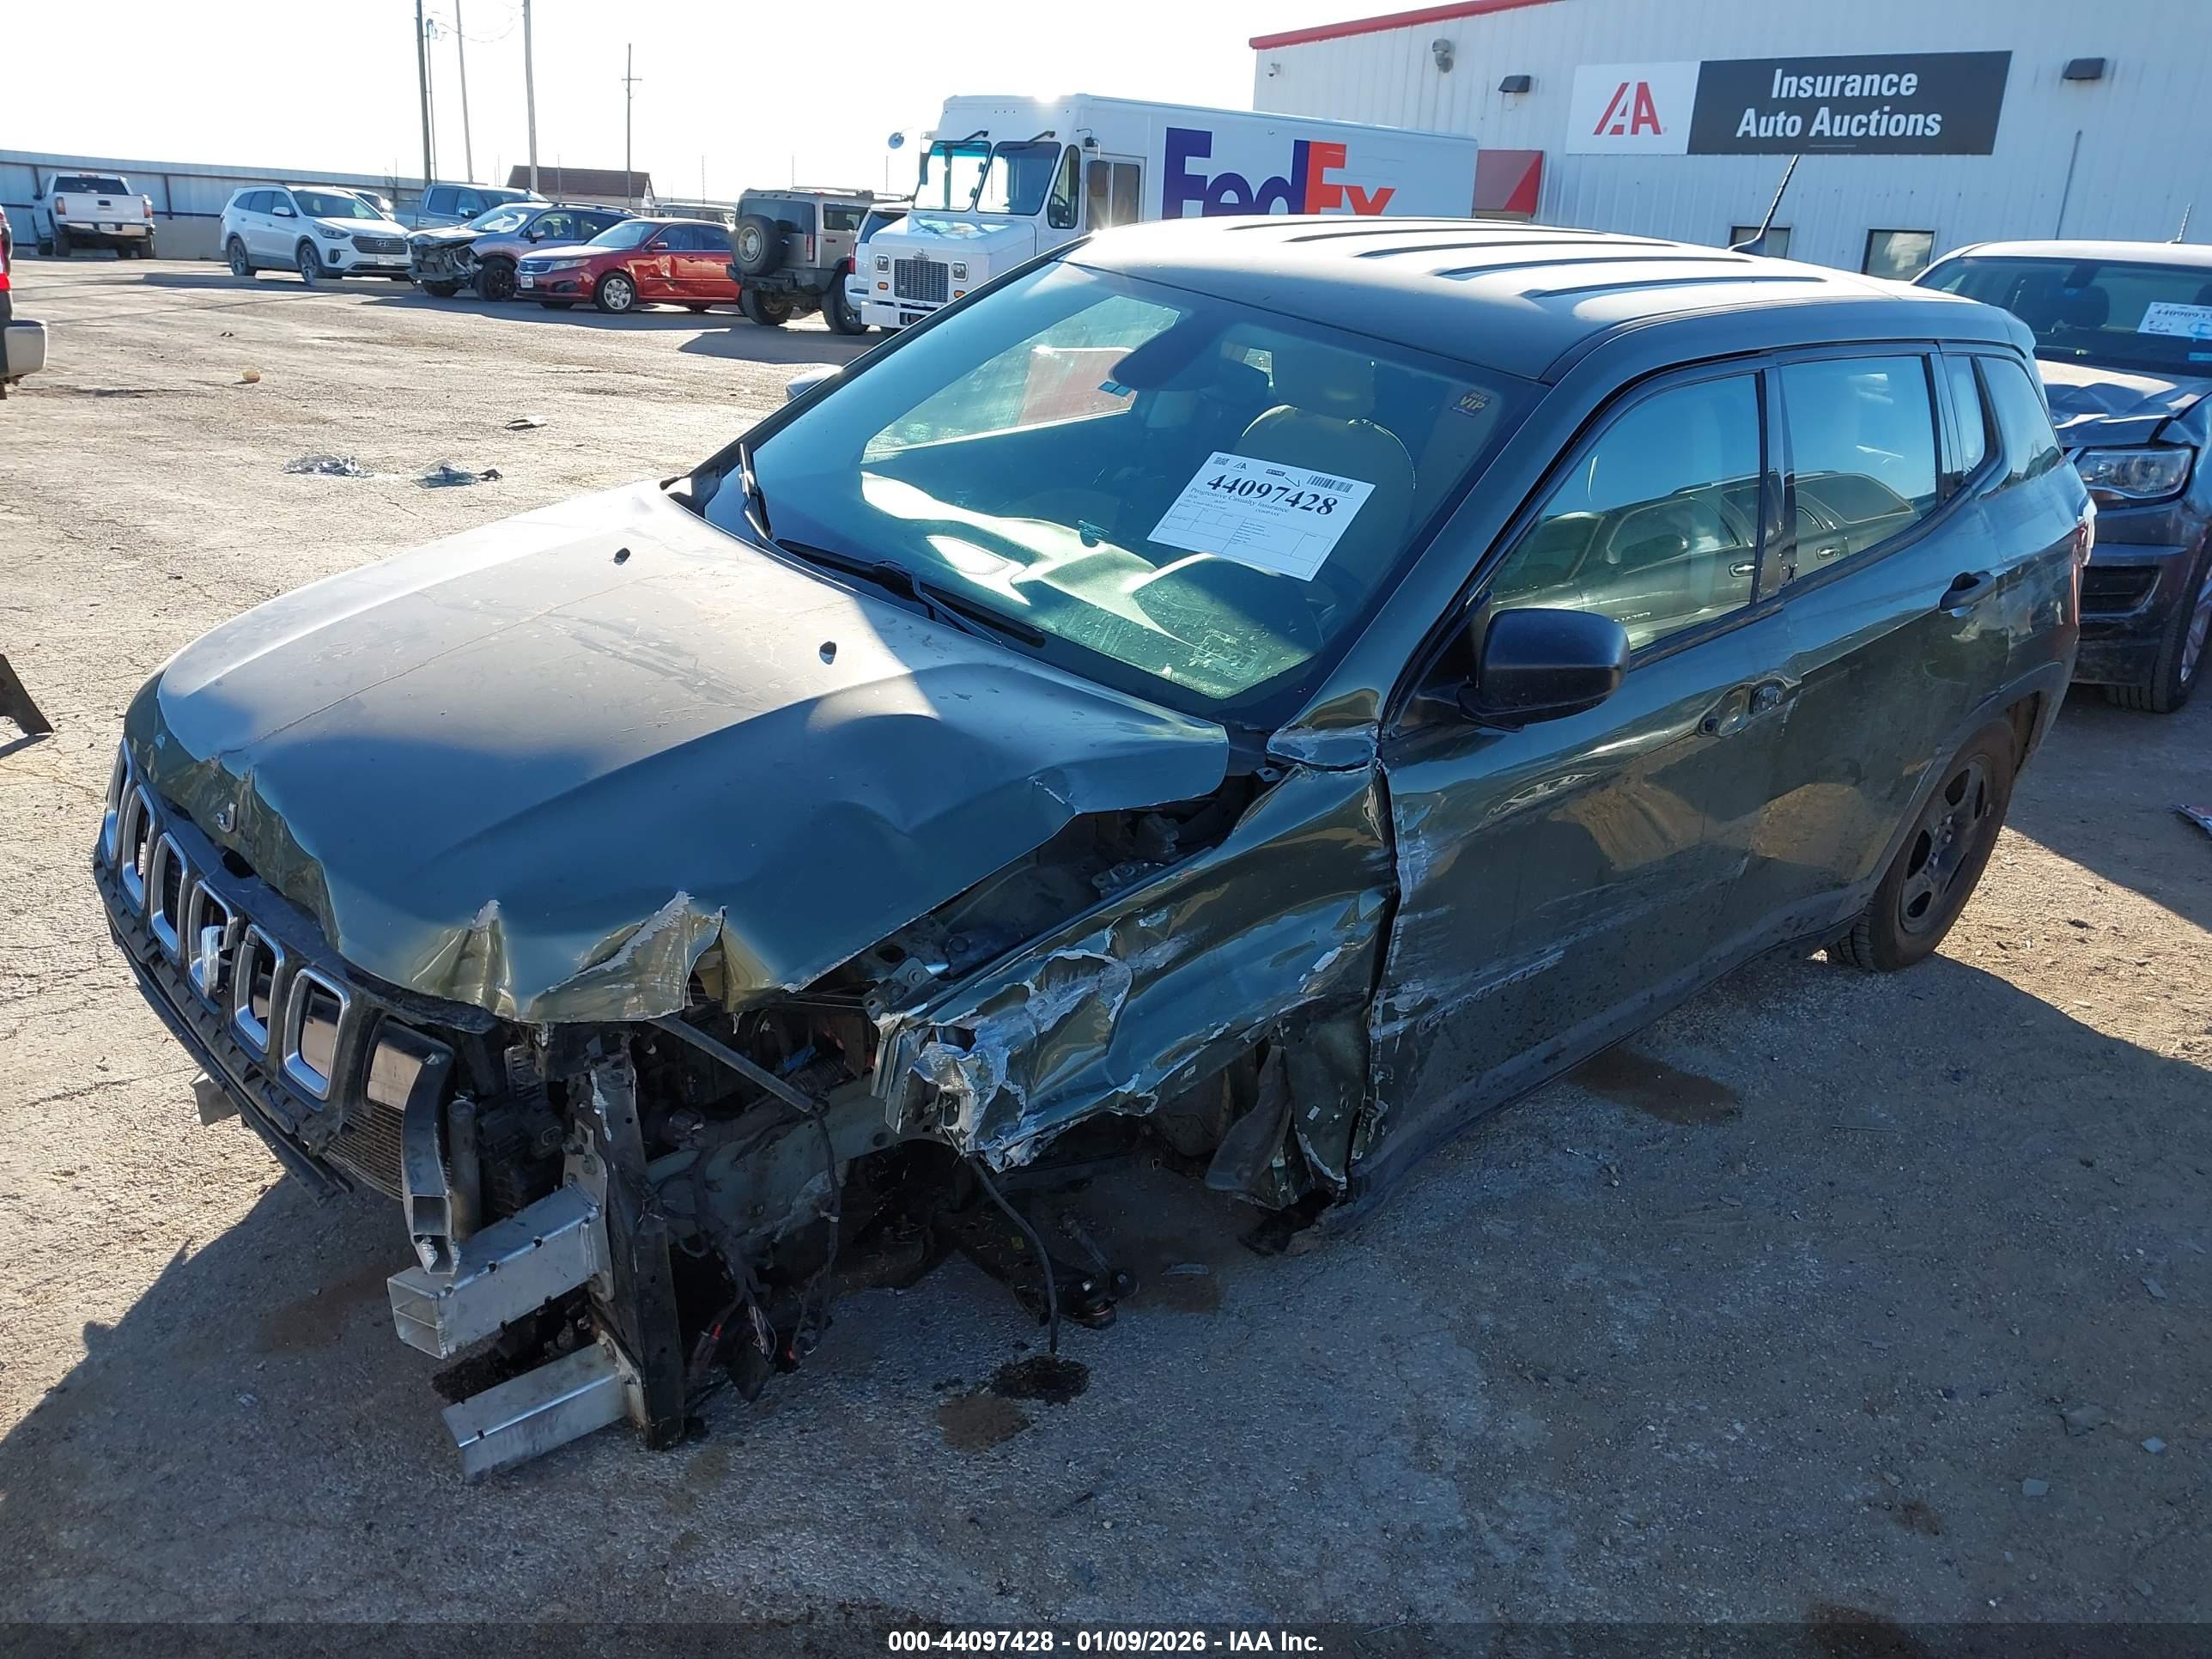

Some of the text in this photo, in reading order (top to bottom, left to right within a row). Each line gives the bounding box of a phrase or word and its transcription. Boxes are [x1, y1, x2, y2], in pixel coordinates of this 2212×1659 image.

[1771, 68, 1917, 99] Insurance
[1736, 106, 1942, 137] Auto Auctions
[1460, 396, 1485, 410] VIP
[1190, 487, 1228, 500] Progressive
[1228, 495, 1256, 507] Casualty
[1257, 501, 1291, 514] Insurance
[1206, 474, 1338, 515] 44097428
